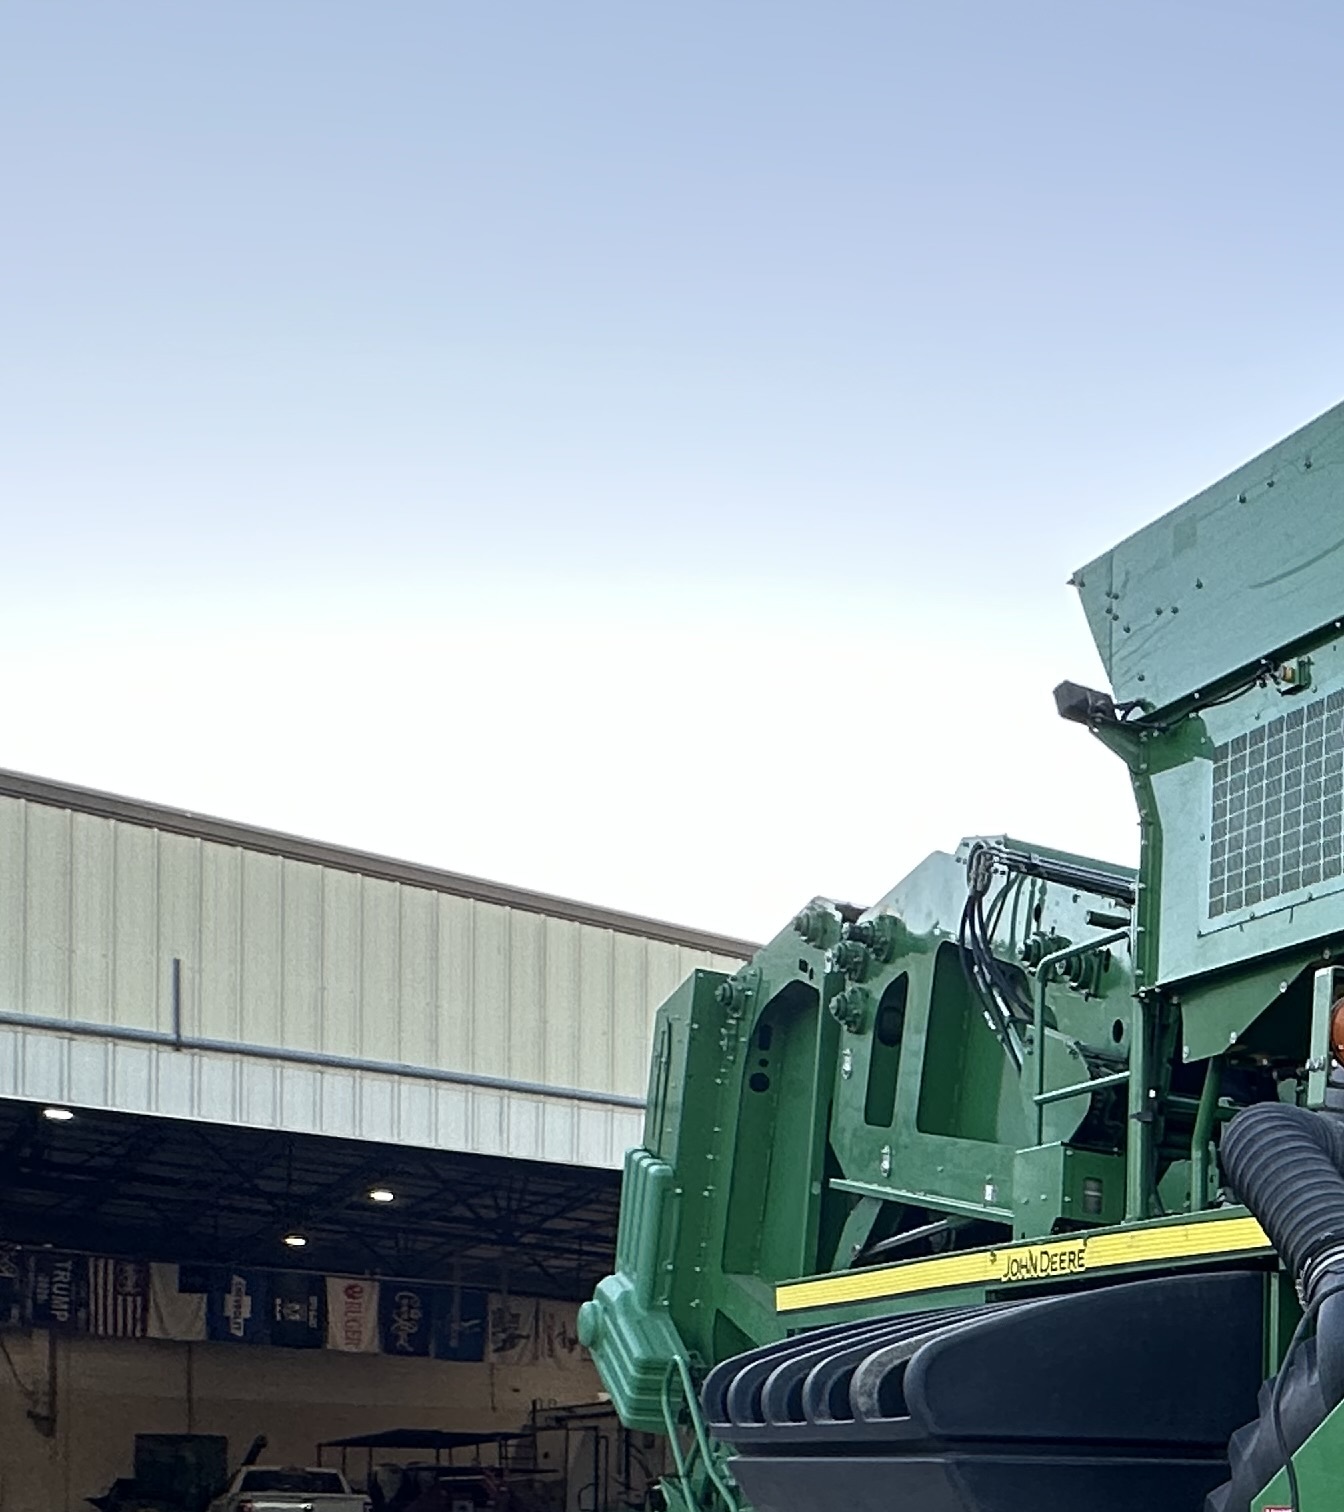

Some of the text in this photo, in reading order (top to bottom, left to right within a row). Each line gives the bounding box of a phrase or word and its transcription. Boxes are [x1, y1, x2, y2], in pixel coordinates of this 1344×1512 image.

[1002, 1249, 1086, 1278] JOHN DEERE
[50, 1260, 72, 1322] TRUMP
[344, 1301, 362, 1346] RUGER
